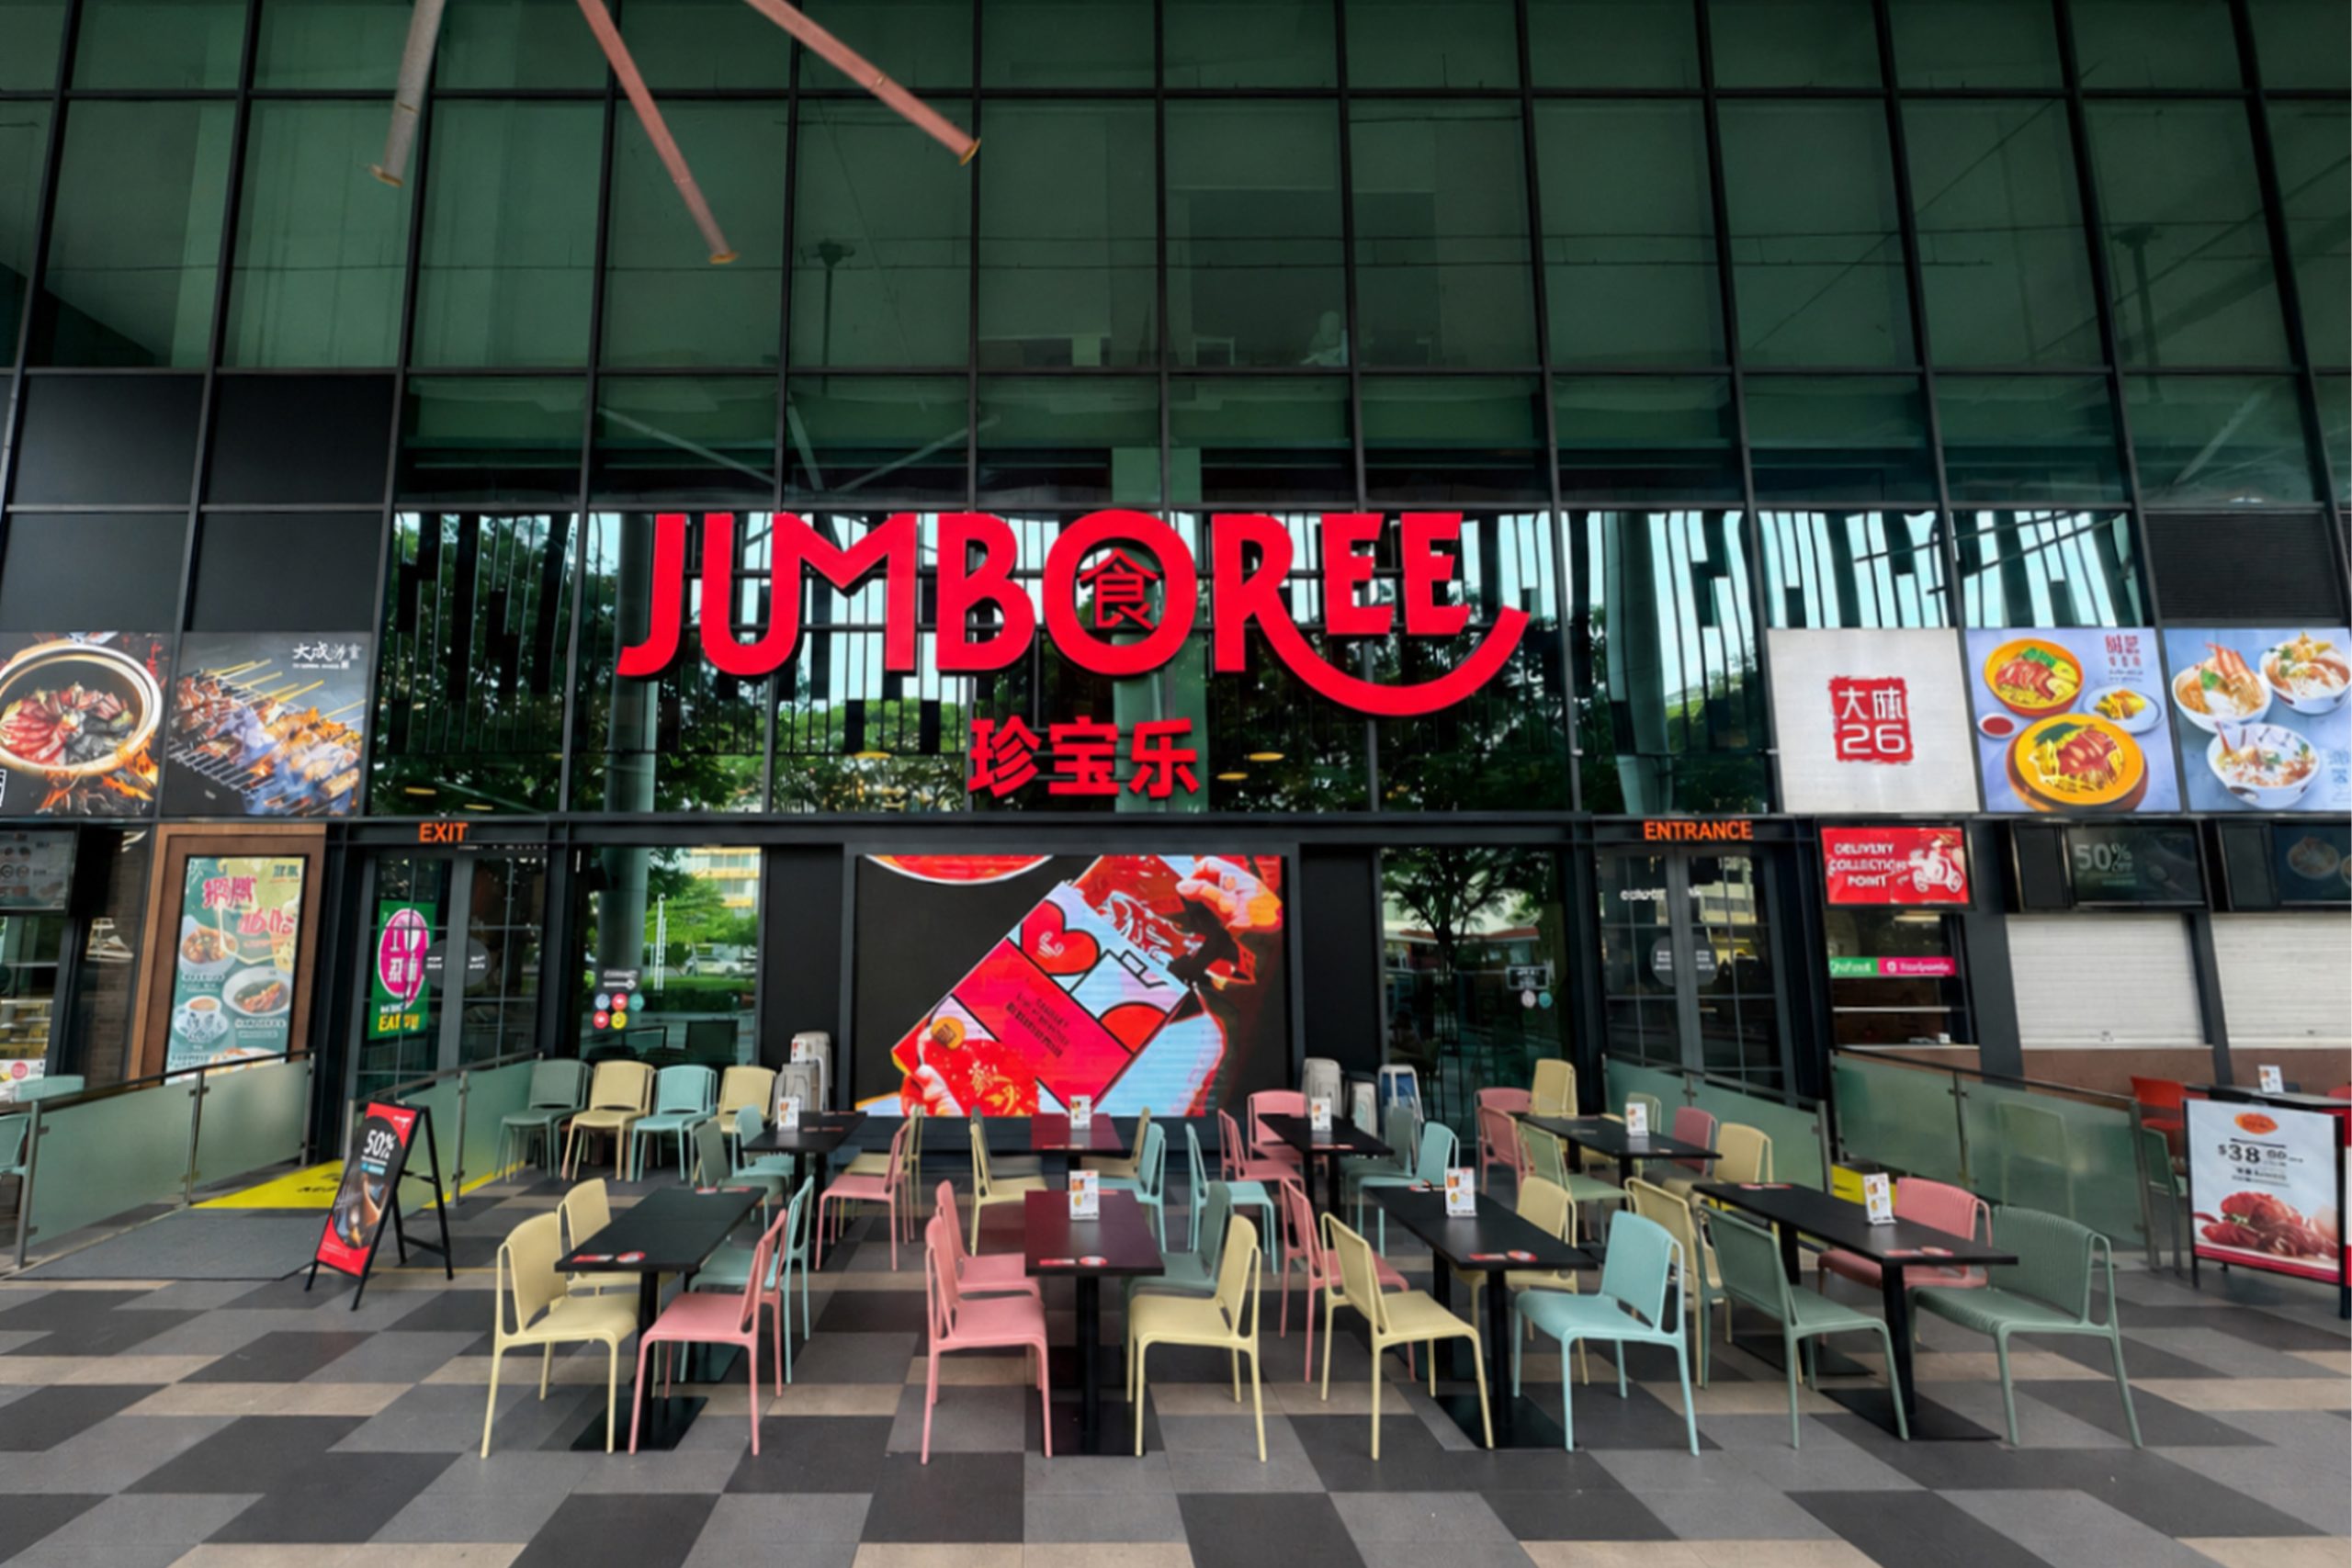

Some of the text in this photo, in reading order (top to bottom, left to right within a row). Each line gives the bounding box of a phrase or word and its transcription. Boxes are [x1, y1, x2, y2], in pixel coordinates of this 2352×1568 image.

[1079, 547, 1159, 632] 食
[616, 509, 1530, 716] JUMBOREE
[1842, 724, 1905, 753] 26
[968, 714, 1199, 800] 珍宝乐
[419, 822, 469, 842] EXIT
[1644, 820, 1753, 840] ENTRANCE
[1835, 843, 1894, 855] DELIVERY
[2075, 842, 2132, 871] 50%
[1829, 859, 1908, 872] COLLECTION
[1848, 875, 1886, 887] POINT
[363, 1129, 397, 1156] 50%
